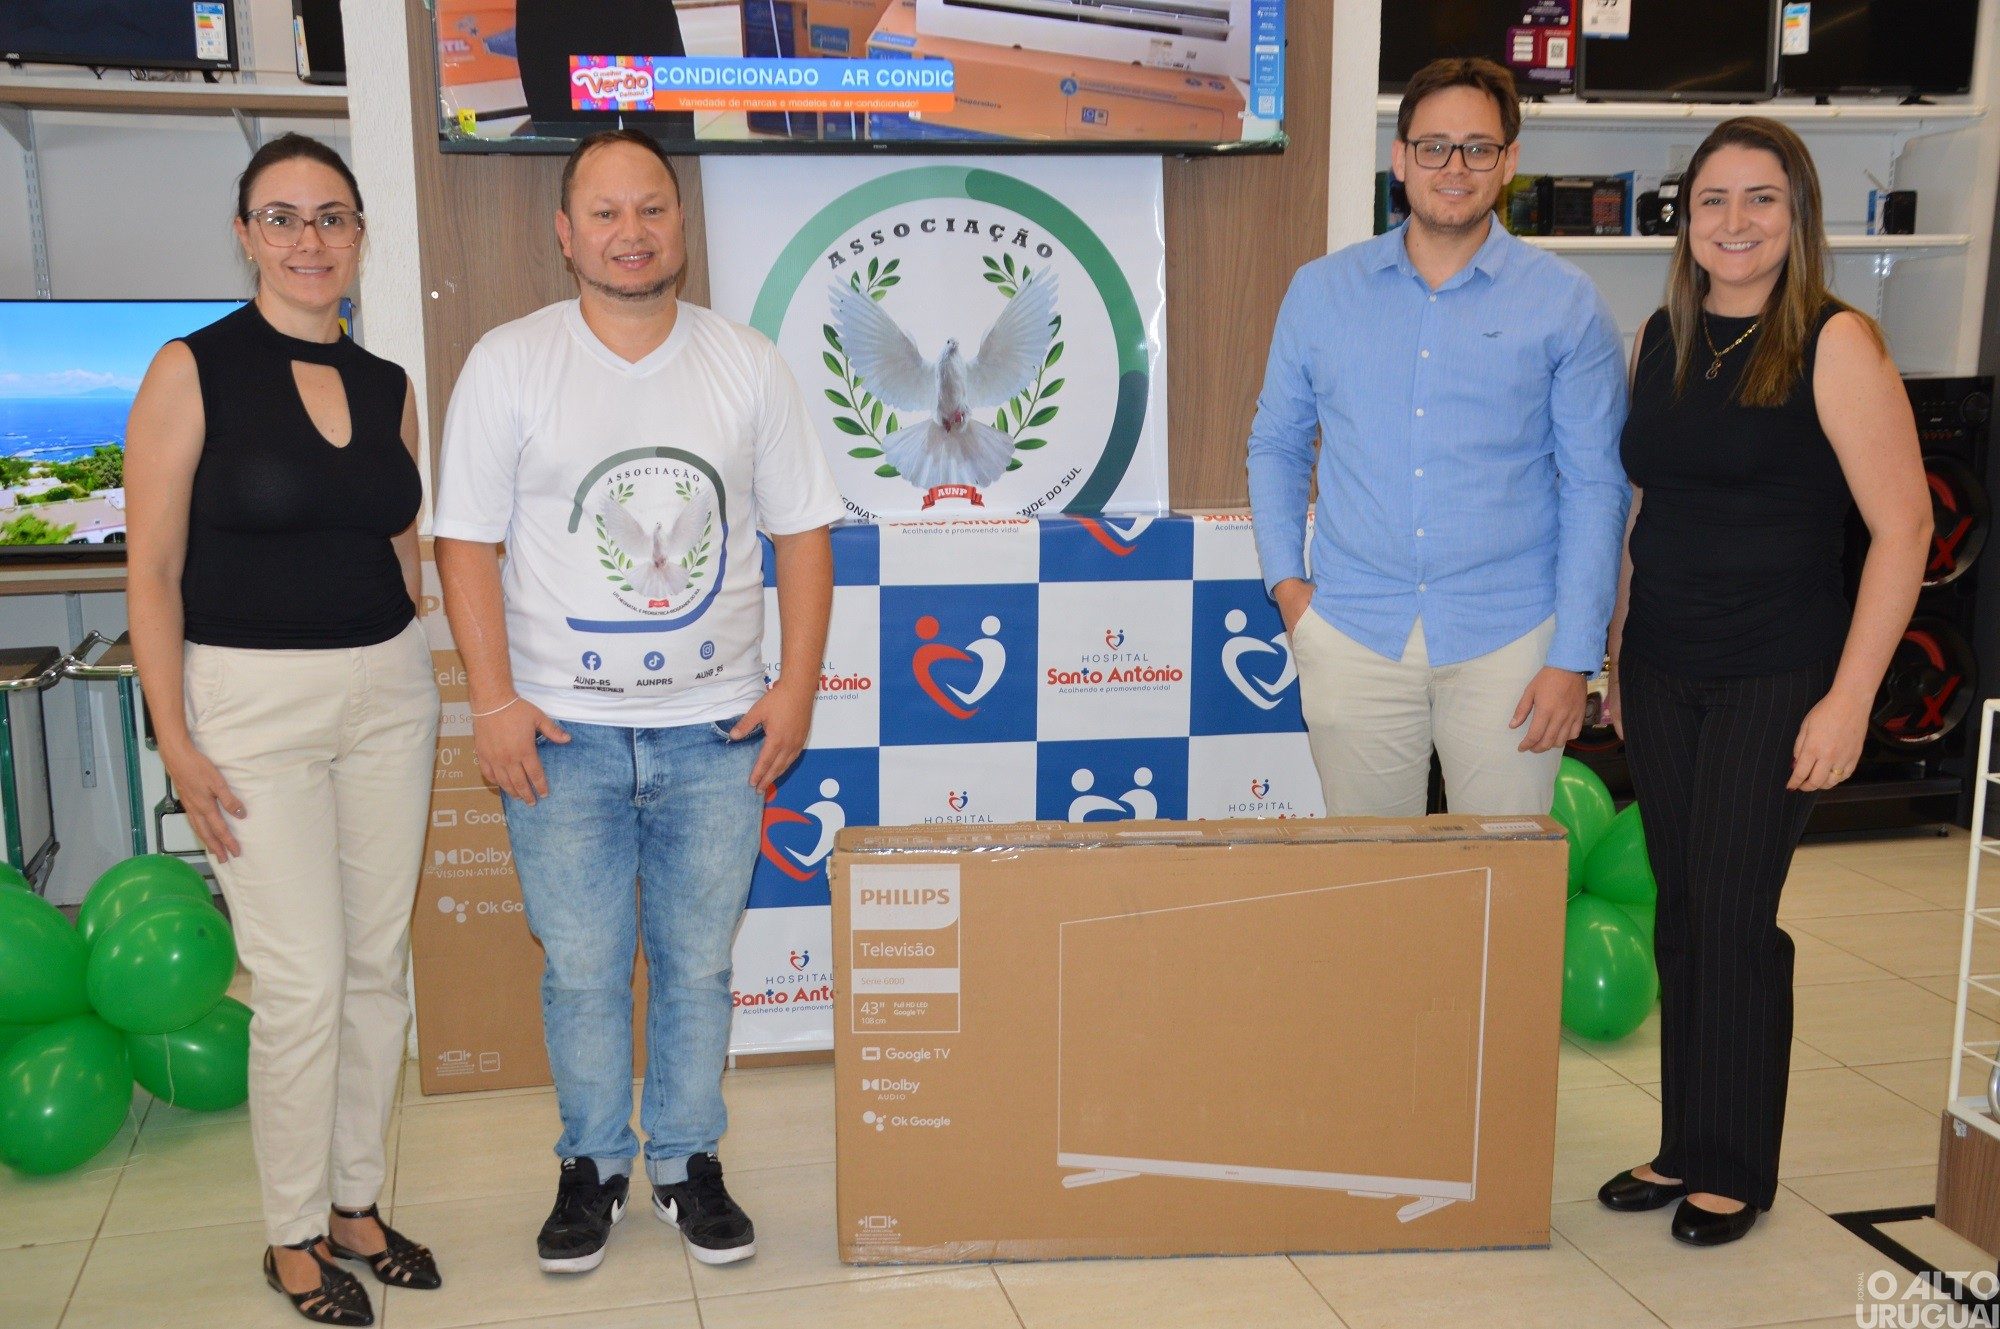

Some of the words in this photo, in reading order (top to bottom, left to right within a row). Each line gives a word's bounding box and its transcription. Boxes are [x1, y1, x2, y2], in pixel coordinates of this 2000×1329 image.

[576, 72, 649, 94] Verão
[654, 67, 819, 86] CONDICIONADO
[841, 68, 870, 87] AR
[876, 69, 954, 88] CONDIC
[679, 96, 726, 107] Variedade
[728, 97, 741, 107] de
[744, 98, 777, 108] marcas
[788, 97, 828, 108] modelos
[829, 97, 841, 108] de
[828, 217, 1053, 269] ASSOCIAÇÃO
[606, 467, 700, 486] ASSOCIAÇÃO
[1045, 484, 1062, 501] DO
[1061, 467, 1082, 487] SUL
[937, 487, 968, 498] AUNP
[902, 527, 943, 536] Acolhendo
[951, 526, 999, 536] promovendo
[1215, 523, 1254, 531] Acolhendo
[1081, 653, 1149, 663] HOSPITAL
[1047, 667, 1103, 685] Santo
[1107, 664, 1183, 683] Antônio
[573, 676, 611, 687] AUNP-RS
[635, 677, 673, 687] AUNPRS
[1058, 686, 1098, 694] Acolhendo
[1105, 685, 1151, 695] promovendo
[1228, 802, 1293, 812] HOSPITAL
[924, 815, 994, 824] HOSPITAL
[460, 847, 512, 866] Dolby
[860, 888, 950, 906] PHILIPS
[476, 900, 499, 915] Ok
[859, 941, 935, 957] Televisão
[765, 973, 834, 985] HOSPITAL
[883, 976, 905, 985] 6000
[731, 988, 788, 1008] Santo
[743, 1007, 784, 1015] Acolhendo
[893, 1009, 916, 1017] Google
[885, 1047, 931, 1063] Google
[933, 1048, 951, 1059] TV
[881, 1078, 920, 1094] Dolby
[877, 1093, 906, 1101] AUDIO
[891, 1115, 908, 1127] Ok
[909, 1116, 951, 1128] Google
